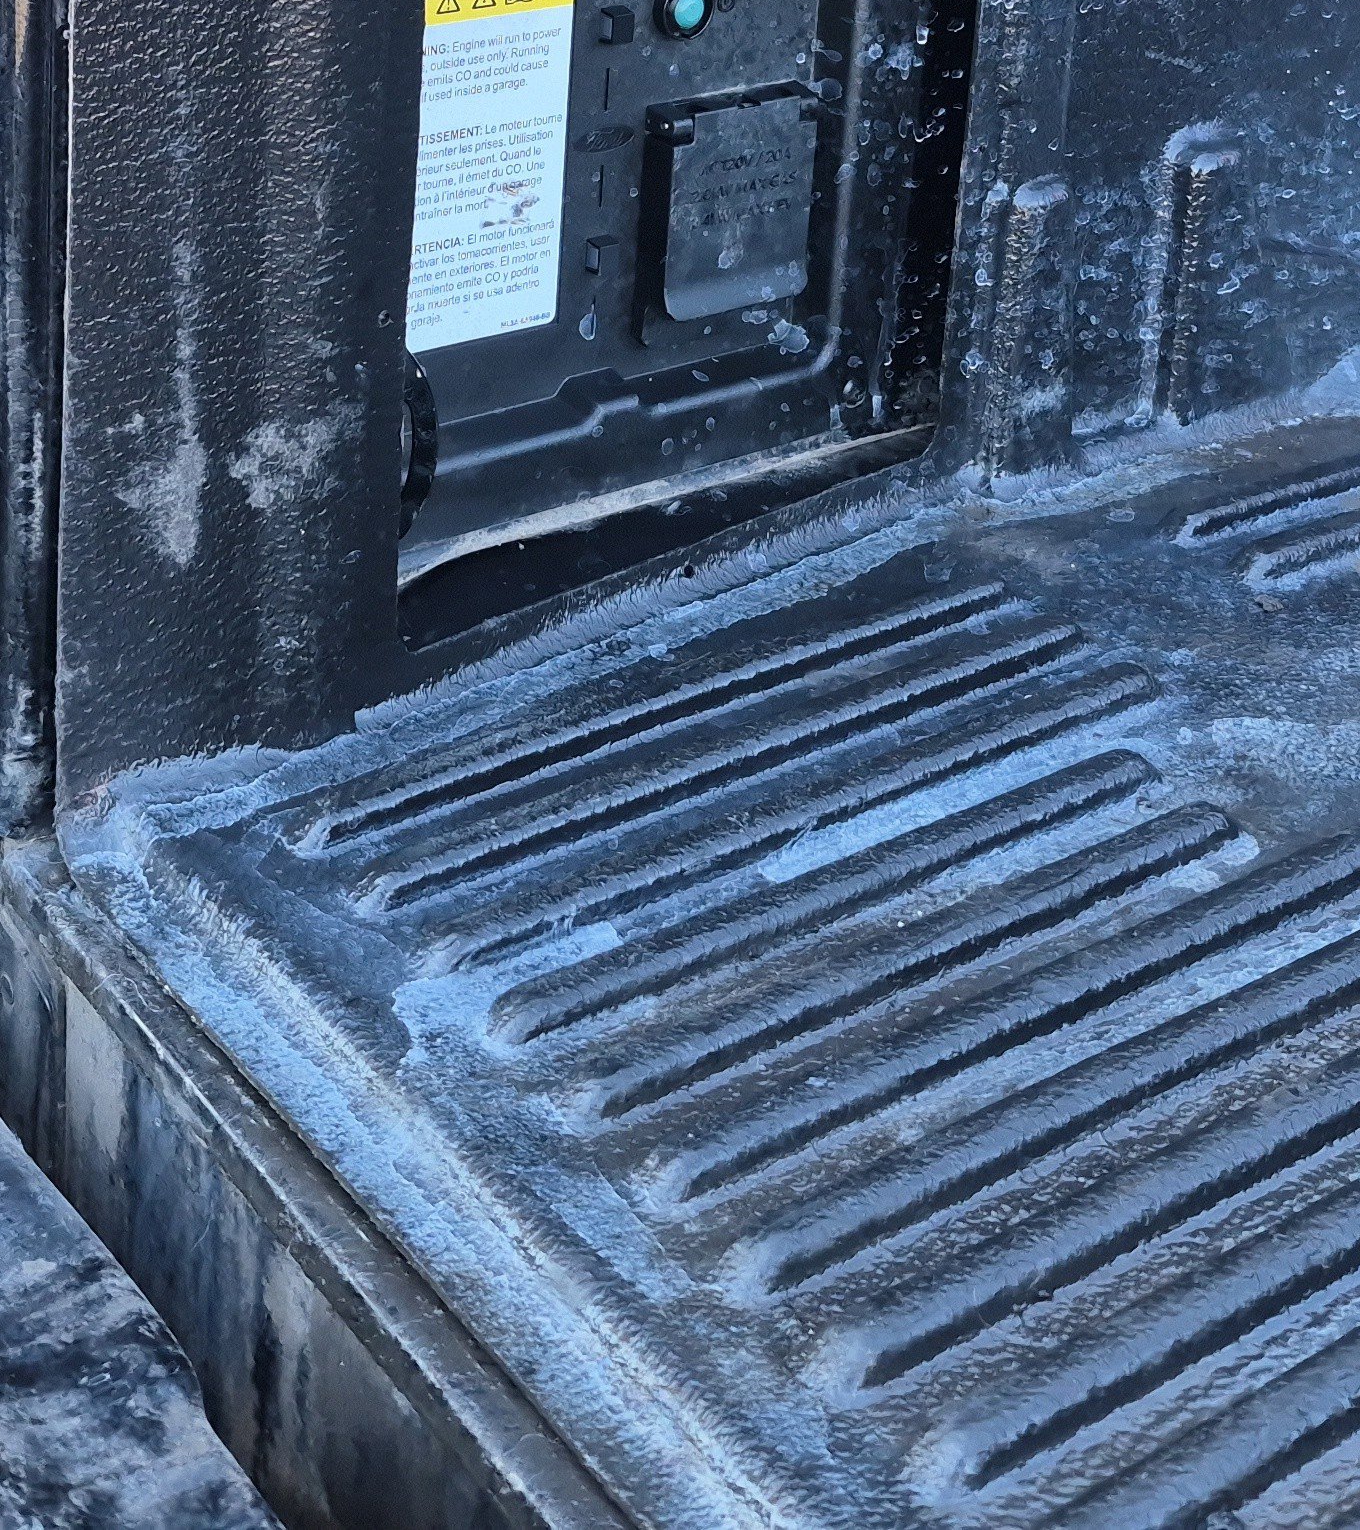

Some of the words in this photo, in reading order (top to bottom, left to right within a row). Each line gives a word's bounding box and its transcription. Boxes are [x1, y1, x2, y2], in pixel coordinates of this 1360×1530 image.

[452, 39, 485, 52] Engine
[487, 34, 502, 46] will
[504, 34, 519, 44] run
[522, 31, 530, 41] to
[532, 27, 561, 42] power
[430, 57, 465, 71] outside
[467, 54, 484, 65] use
[486, 48, 508, 62] only.
[510, 44, 549, 57] Running
[427, 74, 453, 86] emits
[455, 69, 471, 82] CO
[473, 66, 491, 79] and
[493, 62, 518, 75] could
[520, 59, 548, 71] cause
[428, 87, 452, 101] used
[454, 84, 482, 96] inside
[484, 83, 490, 92] a
[492, 78, 527, 93] garage.
[484, 124, 496, 134] Le
[498, 119, 531, 131] moteur
[533, 113, 562, 126] tourne
[458, 143, 472, 153] les
[474, 138, 506, 153] prises.
[508, 130, 553, 145] Utilisation
[499, 146, 531, 161] Quand
[533, 146, 541, 155] le
[423, 177, 456, 190] tourne,
[458, 173, 463, 184] il
[465, 169, 489, 182] émet
[491, 167, 503, 177] du
[526, 161, 545, 171] Une
[433, 192, 439, 203] à
[441, 186, 485, 201] l'intérieur
[487, 181, 507, 193] d'un
[508, 176, 542, 191] garage
[454, 203, 462, 214] la
[467, 233, 476, 244] El
[479, 230, 505, 242] motor
[508, 218, 554, 236] funcionará
[441, 253, 454, 263] los
[457, 240, 527, 260] tomacorrientes,
[530, 235, 549, 246] usar
[434, 270, 446, 279] en
[449, 260, 496, 276] exteriores.
[500, 255, 509, 266] El
[511, 251, 537, 264] motor
[539, 249, 550, 258] en
[456, 276, 482, 289] emite
[484, 271, 500, 283] CO
[502, 271, 508, 282] y
[510, 264, 538, 280] podría
[427, 295, 460, 309] muerte
[462, 291, 470, 302] si
[473, 290, 483, 300] se
[486, 286, 503, 297] usa
[505, 279, 539, 293] adentro
[410, 313, 442, 330] garaje.
